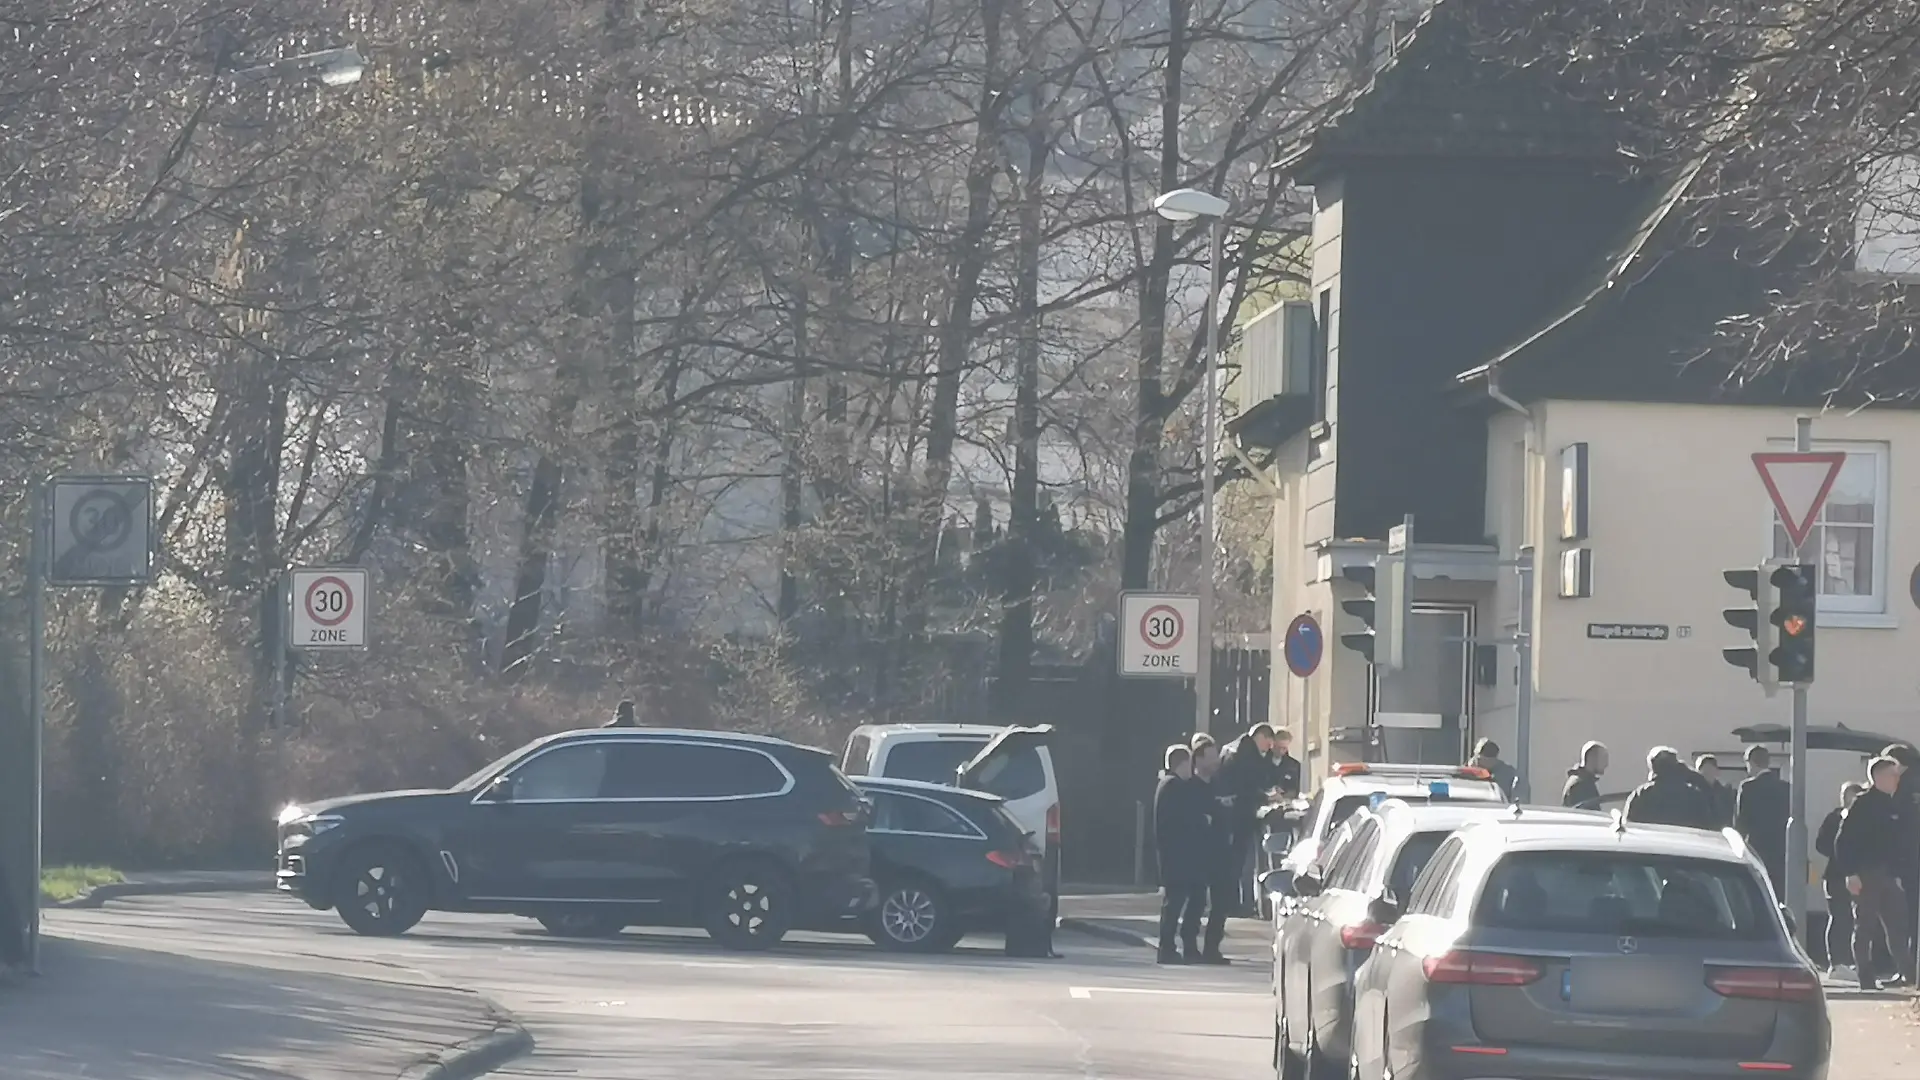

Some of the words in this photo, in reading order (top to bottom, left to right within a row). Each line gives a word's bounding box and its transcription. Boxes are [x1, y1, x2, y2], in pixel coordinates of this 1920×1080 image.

[315, 590, 343, 612] 30
[310, 629, 347, 642] ZONE
[1149, 617, 1175, 638] 30
[1142, 654, 1180, 668] ZONE
